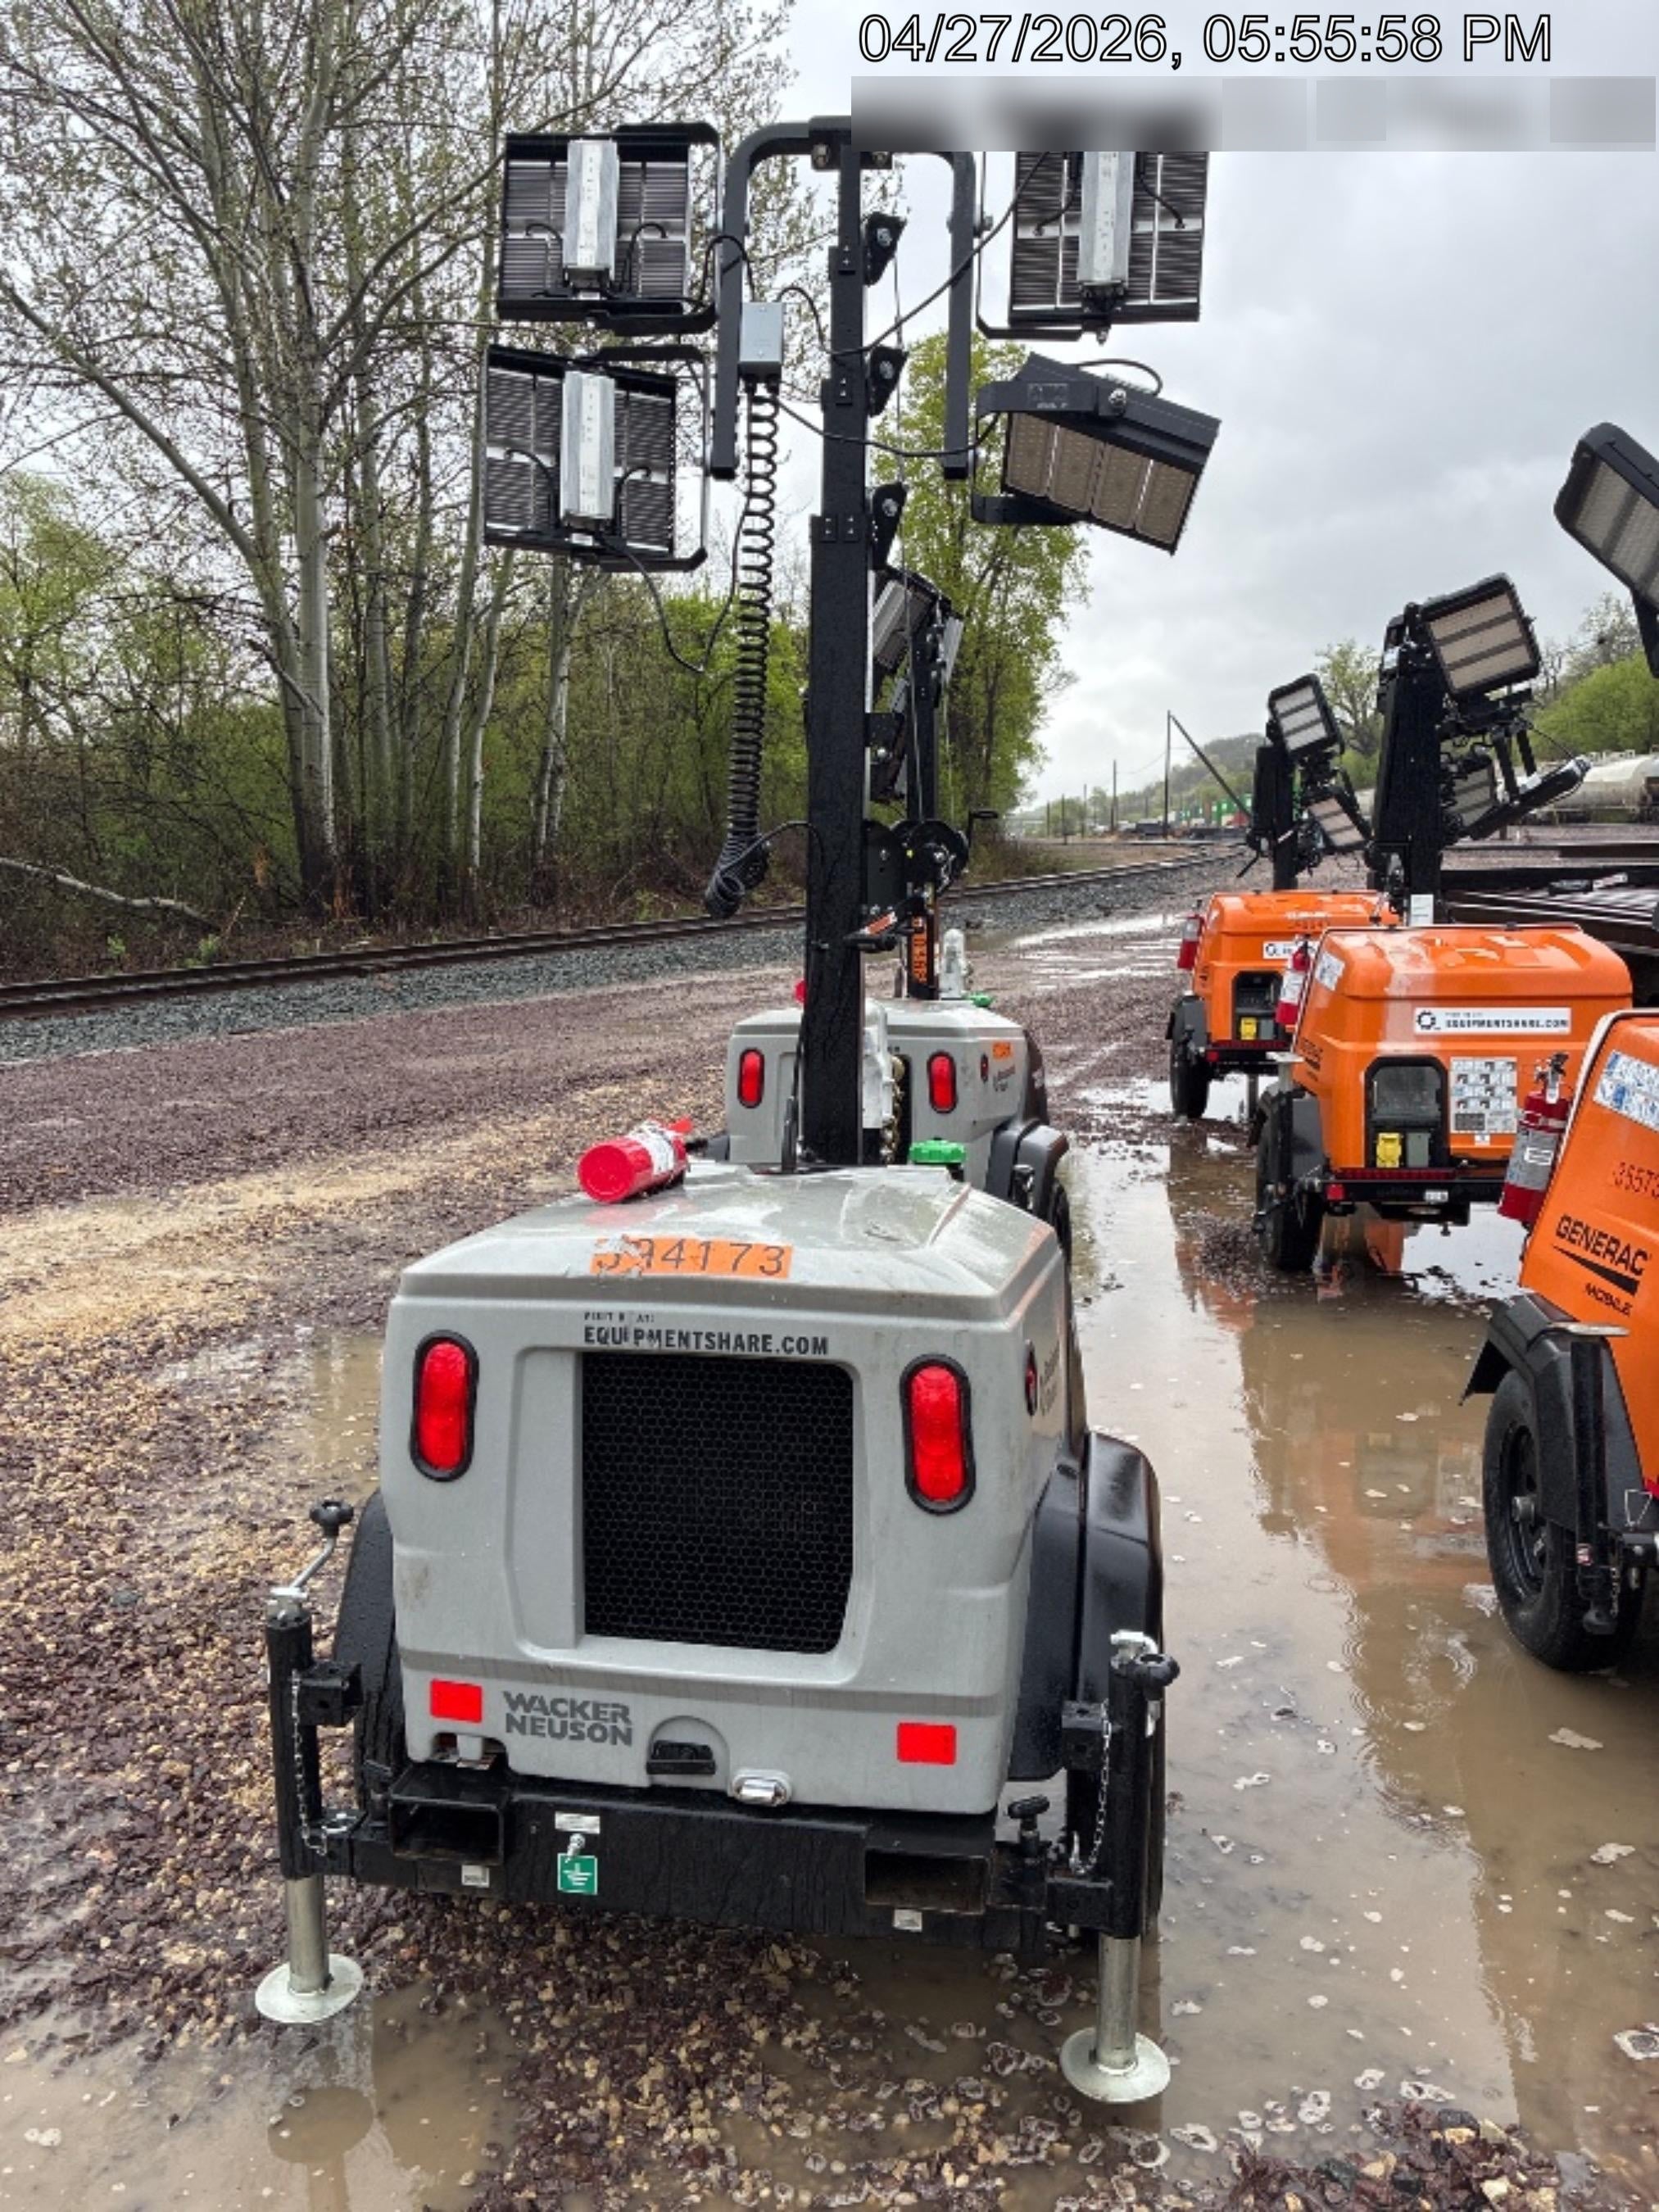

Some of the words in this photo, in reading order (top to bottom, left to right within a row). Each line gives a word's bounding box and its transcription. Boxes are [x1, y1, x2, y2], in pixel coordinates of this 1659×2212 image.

[1555, 1213, 1648, 1276] GENERAC
[584, 1326, 828, 1356] EQUIPMENTSHARE.COM
[502, 1690, 632, 1725] WACKER
[505, 1712, 632, 1747] NEUSON
